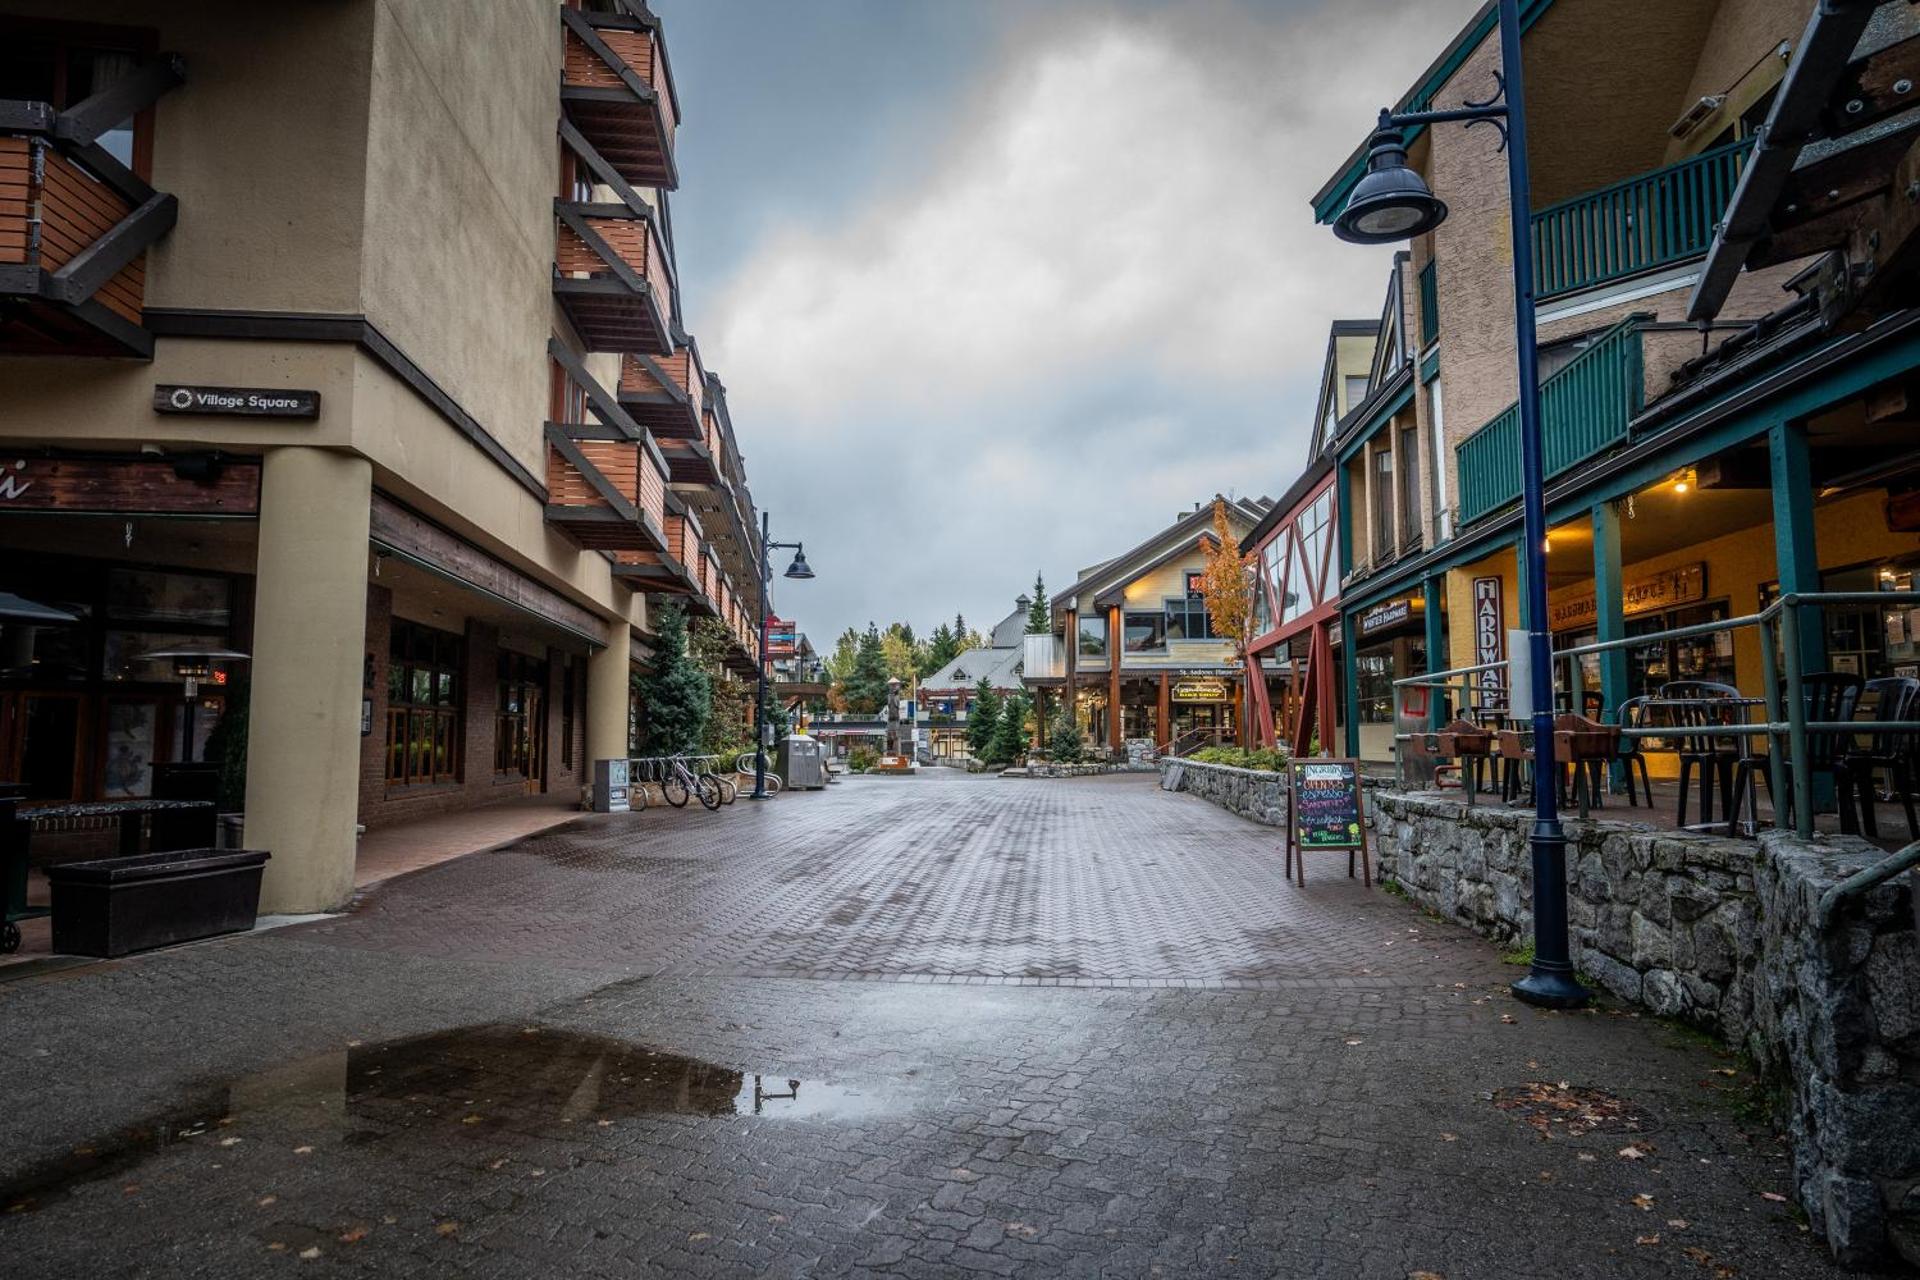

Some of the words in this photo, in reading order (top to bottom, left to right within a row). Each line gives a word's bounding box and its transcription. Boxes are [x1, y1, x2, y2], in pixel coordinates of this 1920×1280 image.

[197, 393, 244, 408] Village
[248, 395, 298, 410] Square
[1478, 581, 1499, 708] HARDWARE
